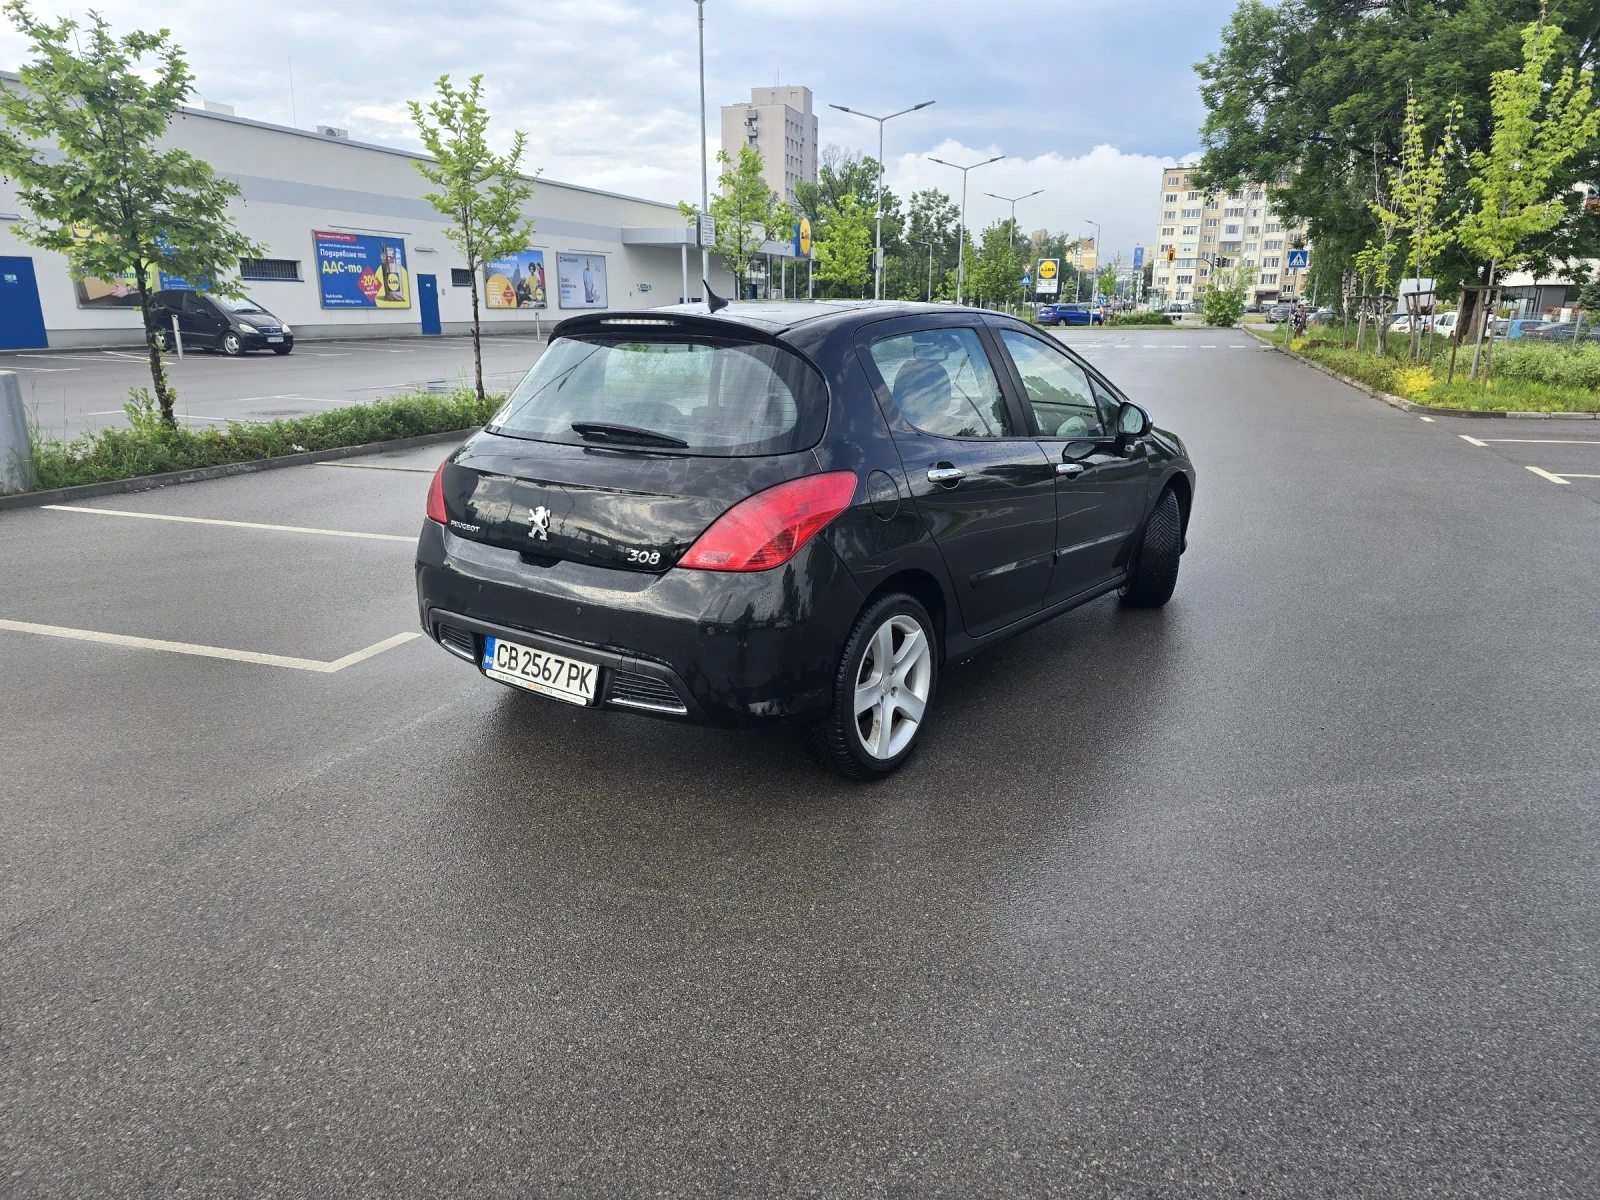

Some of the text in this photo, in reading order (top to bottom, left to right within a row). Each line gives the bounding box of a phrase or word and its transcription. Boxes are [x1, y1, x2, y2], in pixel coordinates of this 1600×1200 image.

[320, 248, 357, 258] Подаряваме
[322, 260, 363, 274] ДДС-то
[450, 519, 480, 532] PEUGEOT
[627, 549, 660, 564] 308
[485, 655, 493, 664] BG
